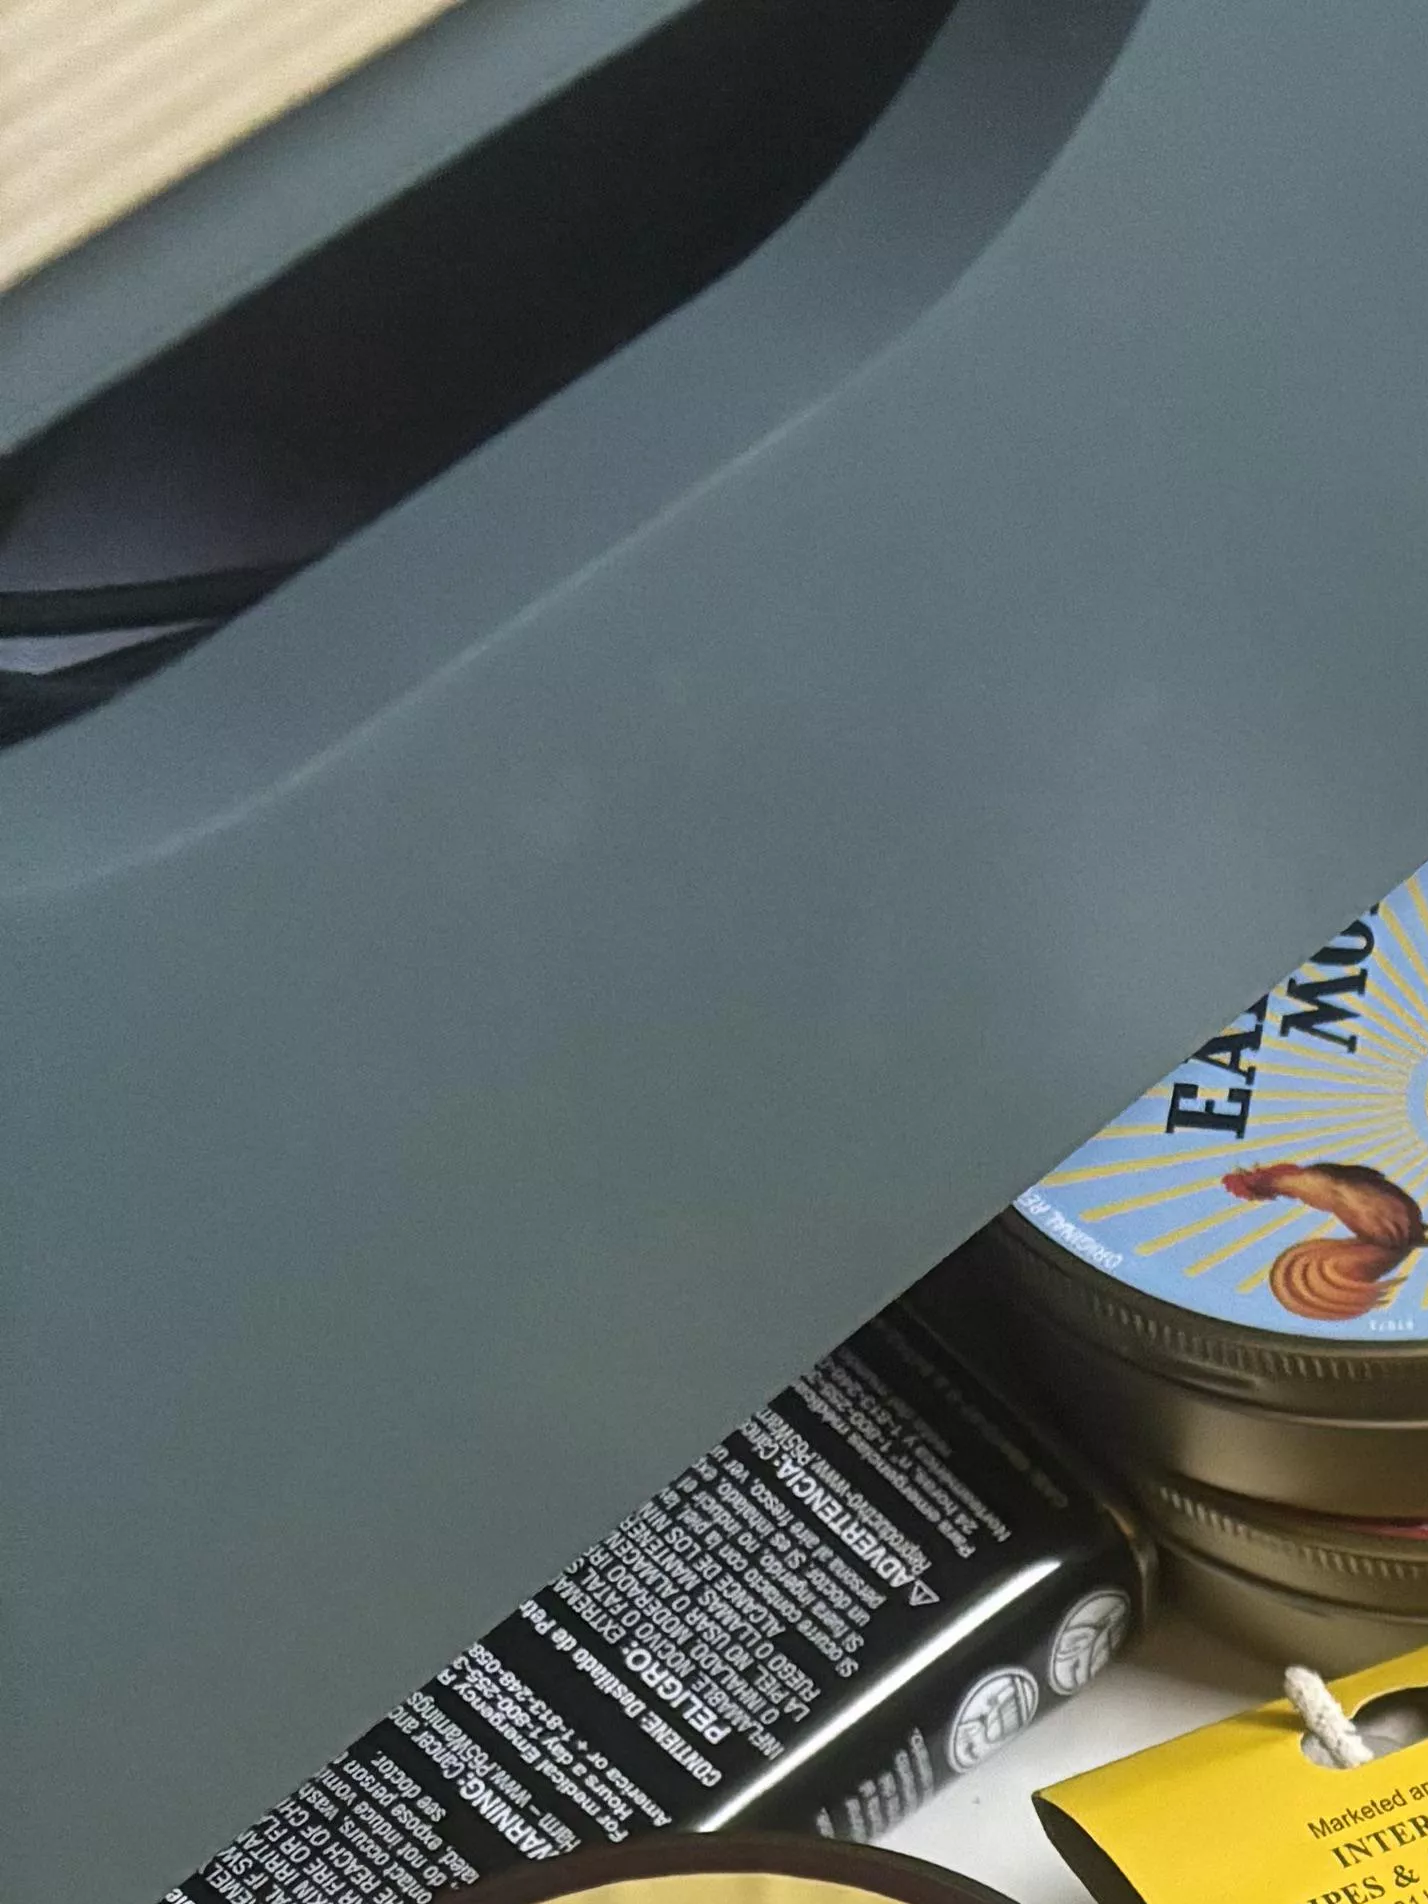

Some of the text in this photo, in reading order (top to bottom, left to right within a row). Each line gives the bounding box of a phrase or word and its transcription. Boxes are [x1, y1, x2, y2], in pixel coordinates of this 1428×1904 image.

[771, 1452, 914, 1591] ADVERTENCIA:
[713, 1572, 786, 1639] ALCANCE
[619, 1639, 730, 1745] PELIGRO:
[634, 1620, 696, 1678] NOCIVO
[452, 1679, 600, 1818] medical Emergency
[570, 1646, 722, 1788] CONTIENE: Destilado
[1307, 1786, 1407, 1840] Marketed
[1391, 1862, 1420, 1889] &
